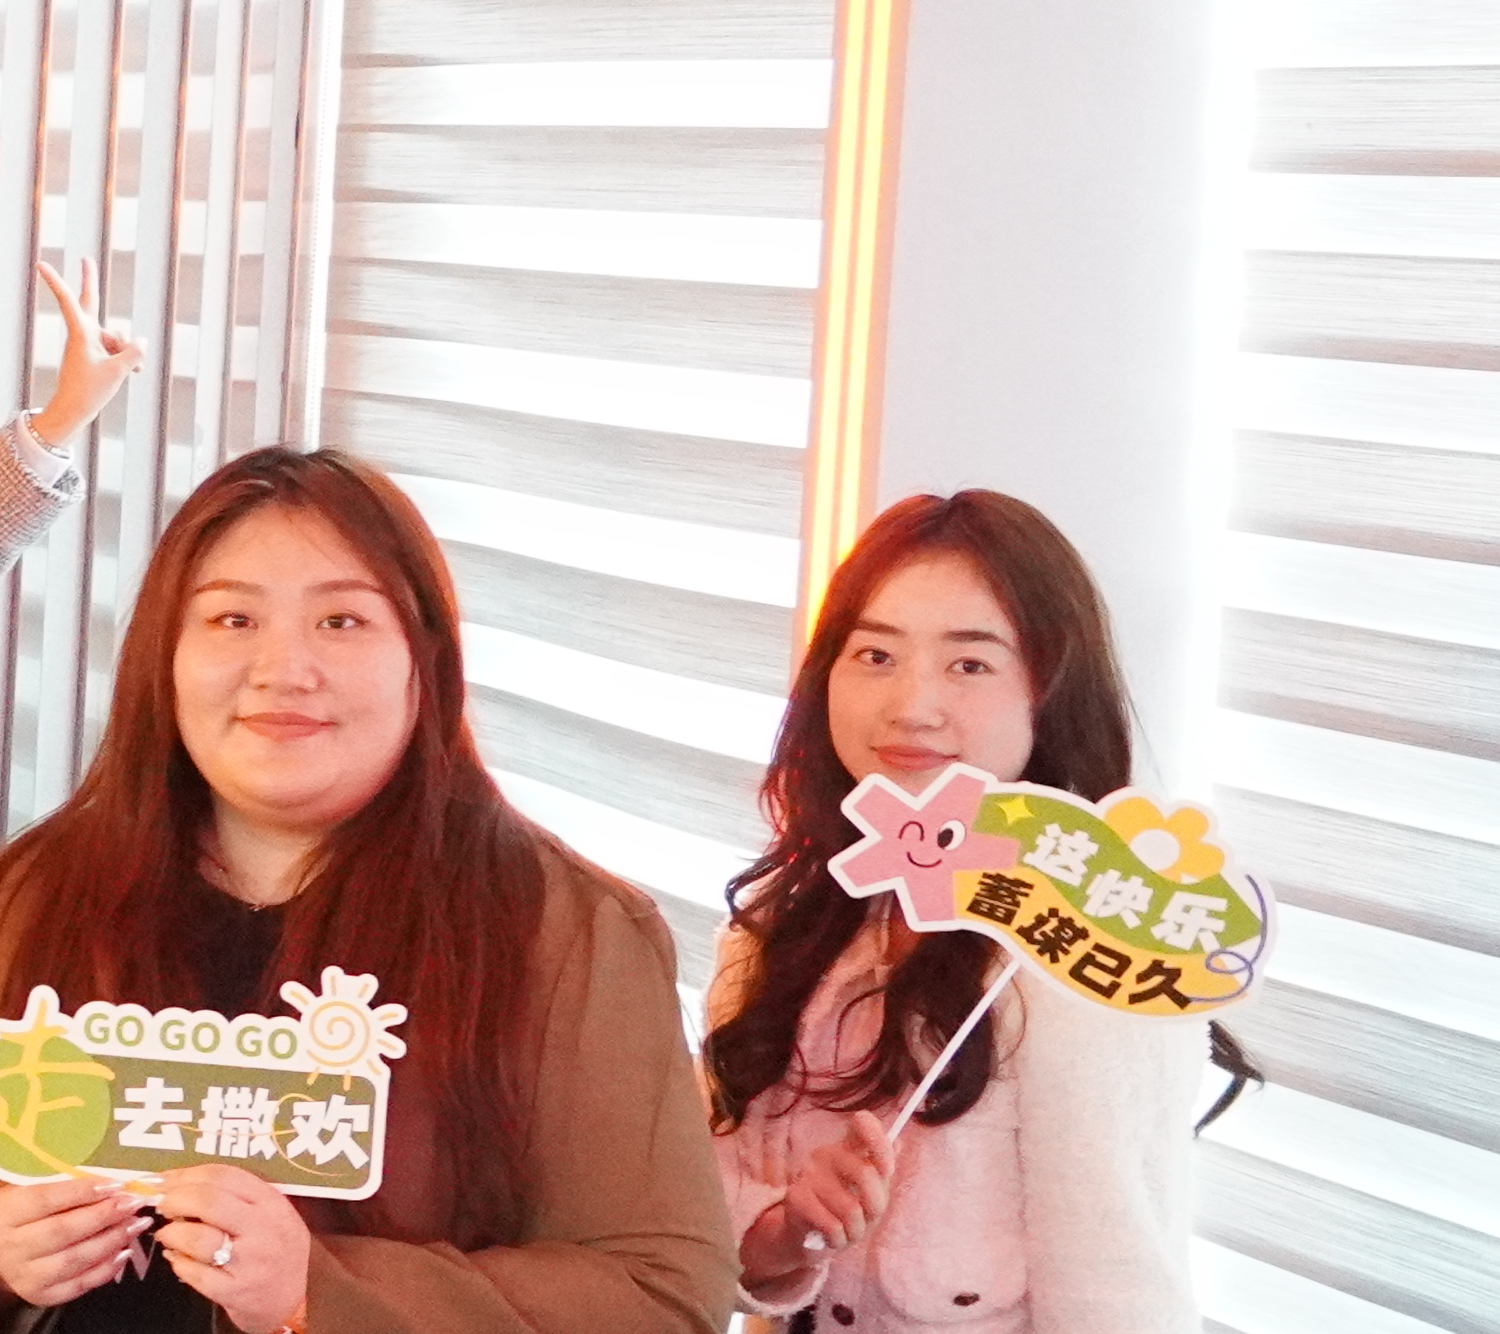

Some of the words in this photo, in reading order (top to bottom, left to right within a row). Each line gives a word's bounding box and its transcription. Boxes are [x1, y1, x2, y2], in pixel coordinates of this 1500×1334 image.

[965, 873, 1194, 1011] 蓄谋已久
[1022, 822, 1230, 954] 这快乐
[82, 1011, 145, 1046] GO
[158, 1018, 222, 1053] GO
[235, 1024, 298, 1060] GO
